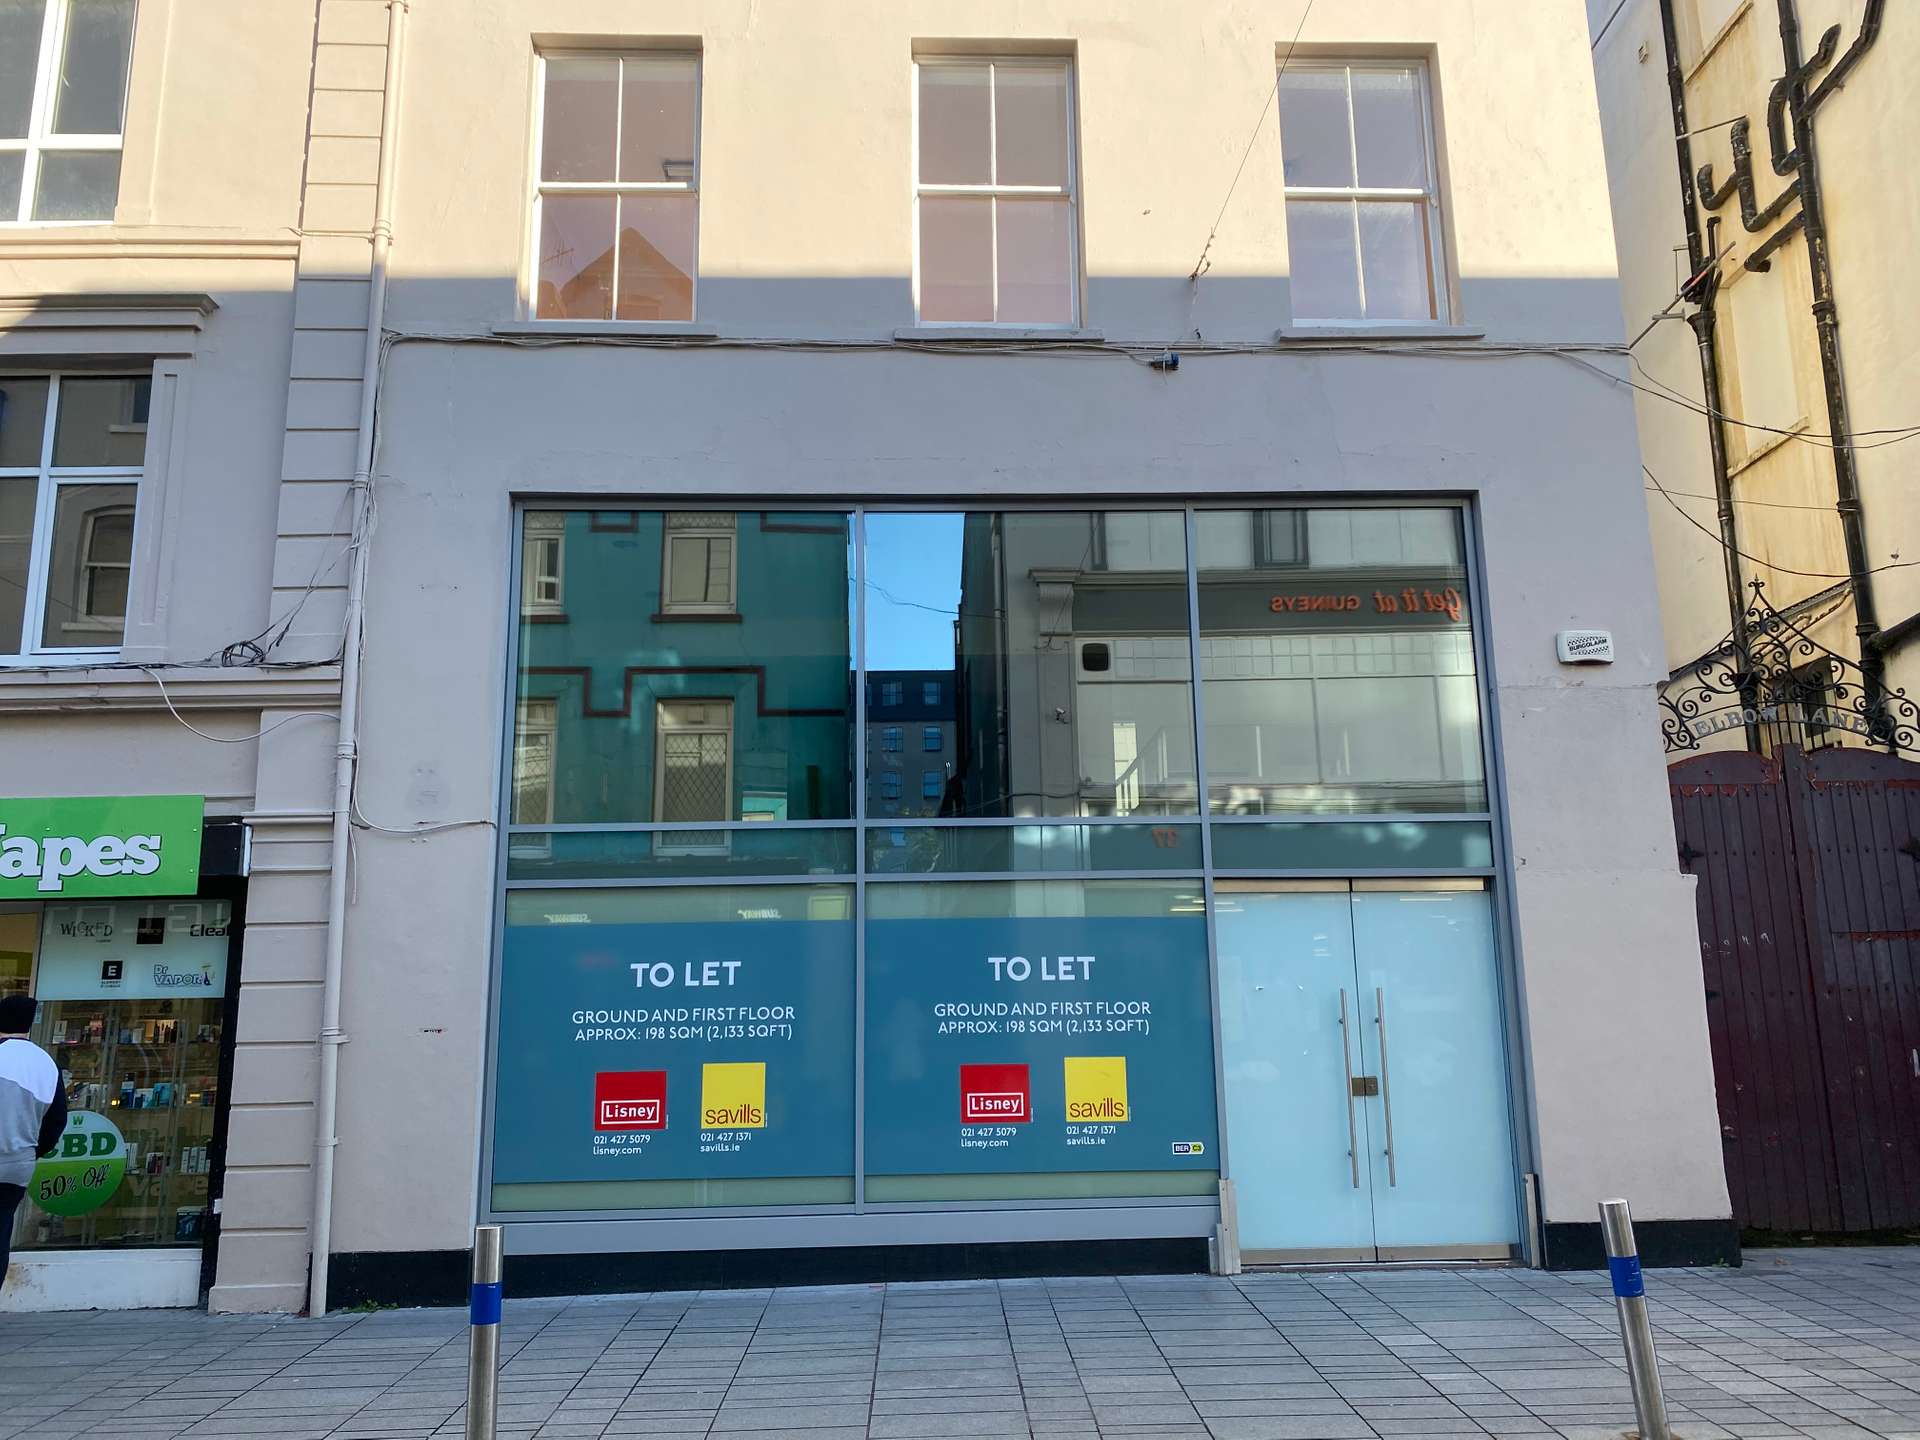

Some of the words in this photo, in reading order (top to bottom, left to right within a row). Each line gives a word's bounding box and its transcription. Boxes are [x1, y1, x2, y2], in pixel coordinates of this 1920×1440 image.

[1693, 706, 1778, 735] ELBOW
[1797, 704, 1870, 734] LANE
[0, 823, 162, 892] apes
[190, 923, 230, 937] Elea
[153, 964, 169, 975] Dr
[630, 962, 675, 988] TO
[684, 961, 742, 987] LET
[987, 956, 1032, 981] TO
[1041, 956, 1095, 981] LET
[572, 1009, 648, 1024] GROUND
[651, 1008, 689, 1023] AND
[692, 1007, 735, 1022] FIRST
[738, 1006, 795, 1021] FLOOR
[934, 1003, 1008, 1017] GROUND
[1011, 1002, 1047, 1016] AND
[1051, 1002, 1093, 1016] FIRST
[1096, 1001, 1152, 1015] FLOOR
[575, 1028, 641, 1041] APPROX:
[645, 1027, 666, 1040] 198
[669, 1026, 703, 1040] SQM
[707, 1025, 744, 1042] (2,133
[747, 1024, 793, 1041] SQFT)
[938, 1021, 1002, 1034] APPROX:
[1006, 1020, 1026, 1033] 198
[1029, 1020, 1063, 1034] SQM
[1066, 1019, 1102, 1036] (2,133
[1106, 1018, 1150, 1036] SQFT)
[605, 1104, 656, 1120] Lisney
[971, 1097, 1020, 1113] Lisney
[1069, 1097, 1125, 1118] savills
[73, 1115, 84, 1126] W
[705, 1104, 762, 1125] savills
[700, 1133, 714, 1142] 021
[716, 1132, 734, 1142] 427
[736, 1132, 752, 1142] 1371
[961, 1128, 975, 1137] 021
[977, 1128, 994, 1137] 427
[996, 1127, 1018, 1137] 5079
[1066, 1126, 1080, 1135] 021
[1082, 1126, 1099, 1135] 427
[1100, 1126, 1116, 1135] 1371
[42, 1132, 117, 1159] BD
[593, 1135, 608, 1145] 021
[610, 1135, 628, 1144] 427
[629, 1134, 651, 1144] 5079
[960, 1138, 1009, 1149] lisney.com
[1066, 1136, 1106, 1146] savills.ie
[592, 1146, 642, 1156] lisney.com
[700, 1144, 741, 1153] savills.ie
[40, 1175, 77, 1200] 50%
[82, 1163, 110, 1189] Off
